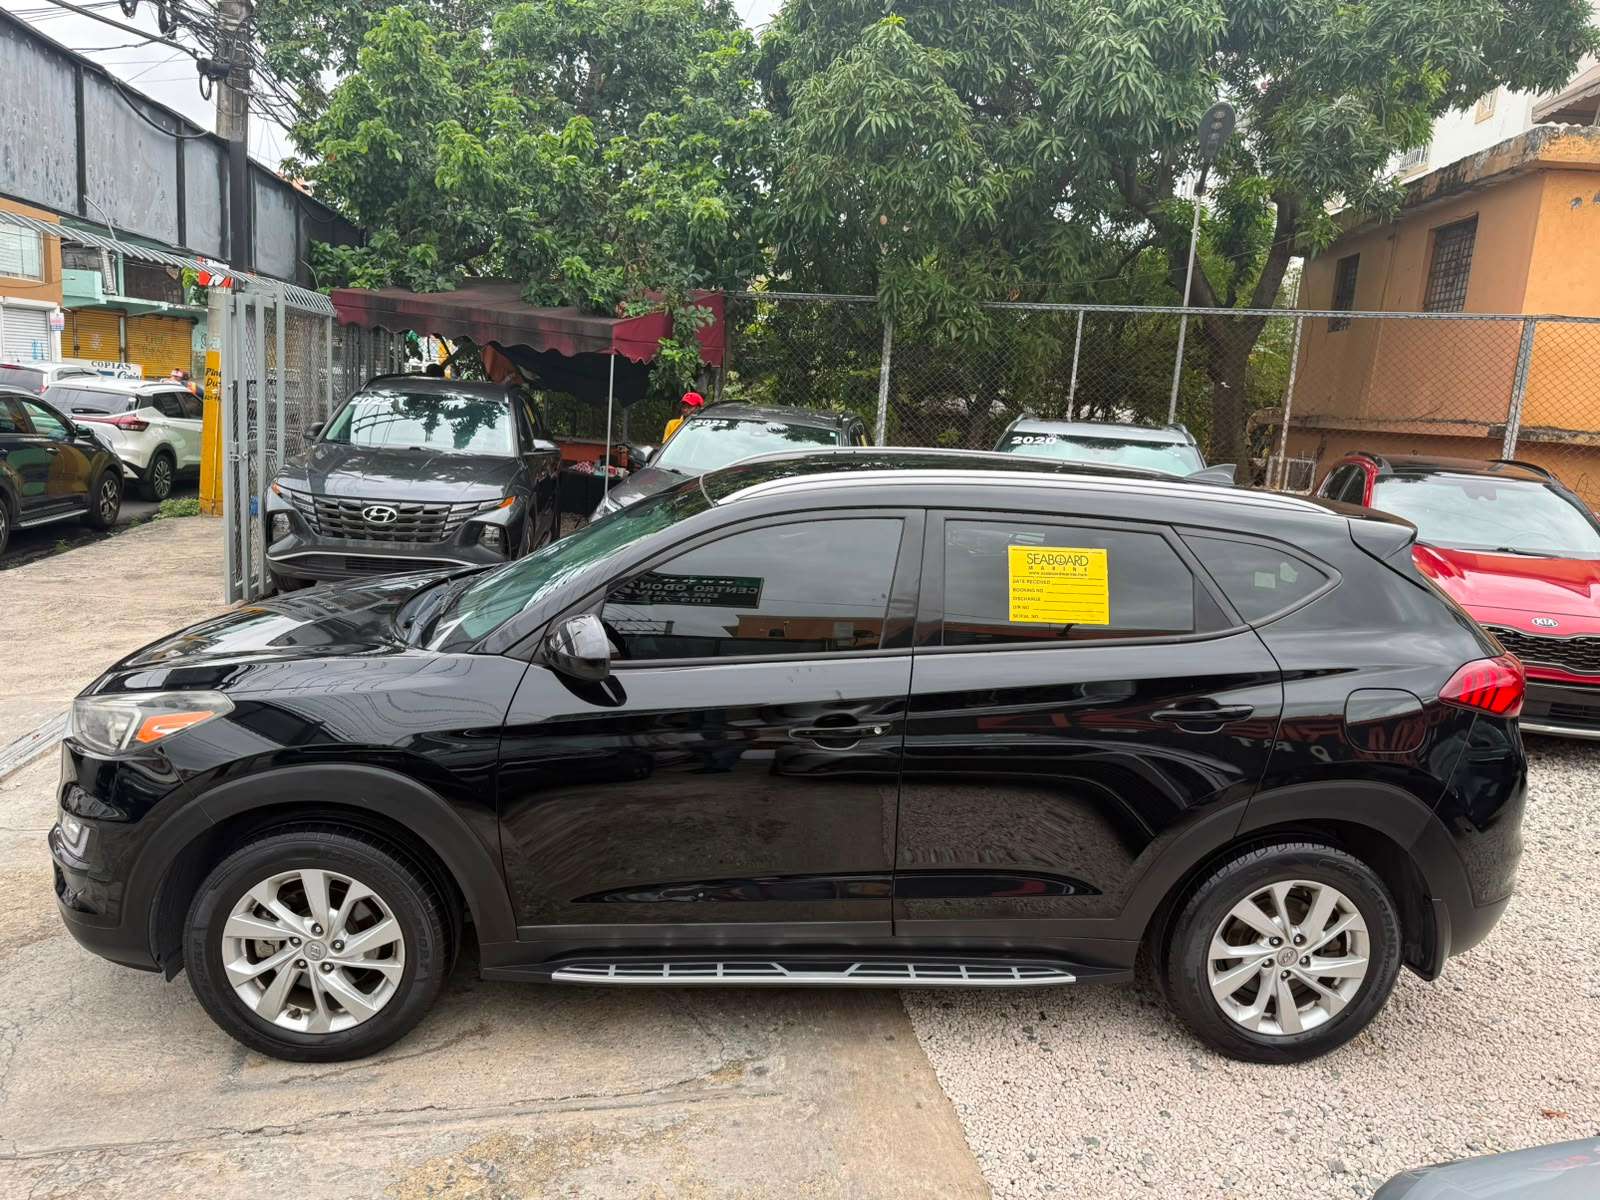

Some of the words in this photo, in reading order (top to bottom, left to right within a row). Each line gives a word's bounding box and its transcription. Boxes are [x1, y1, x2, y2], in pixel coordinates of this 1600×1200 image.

[91, 360, 132, 370] COPIAS
[1027, 552, 1089, 566] SEABOARD
[1535, 617, 1556, 627] KIA
